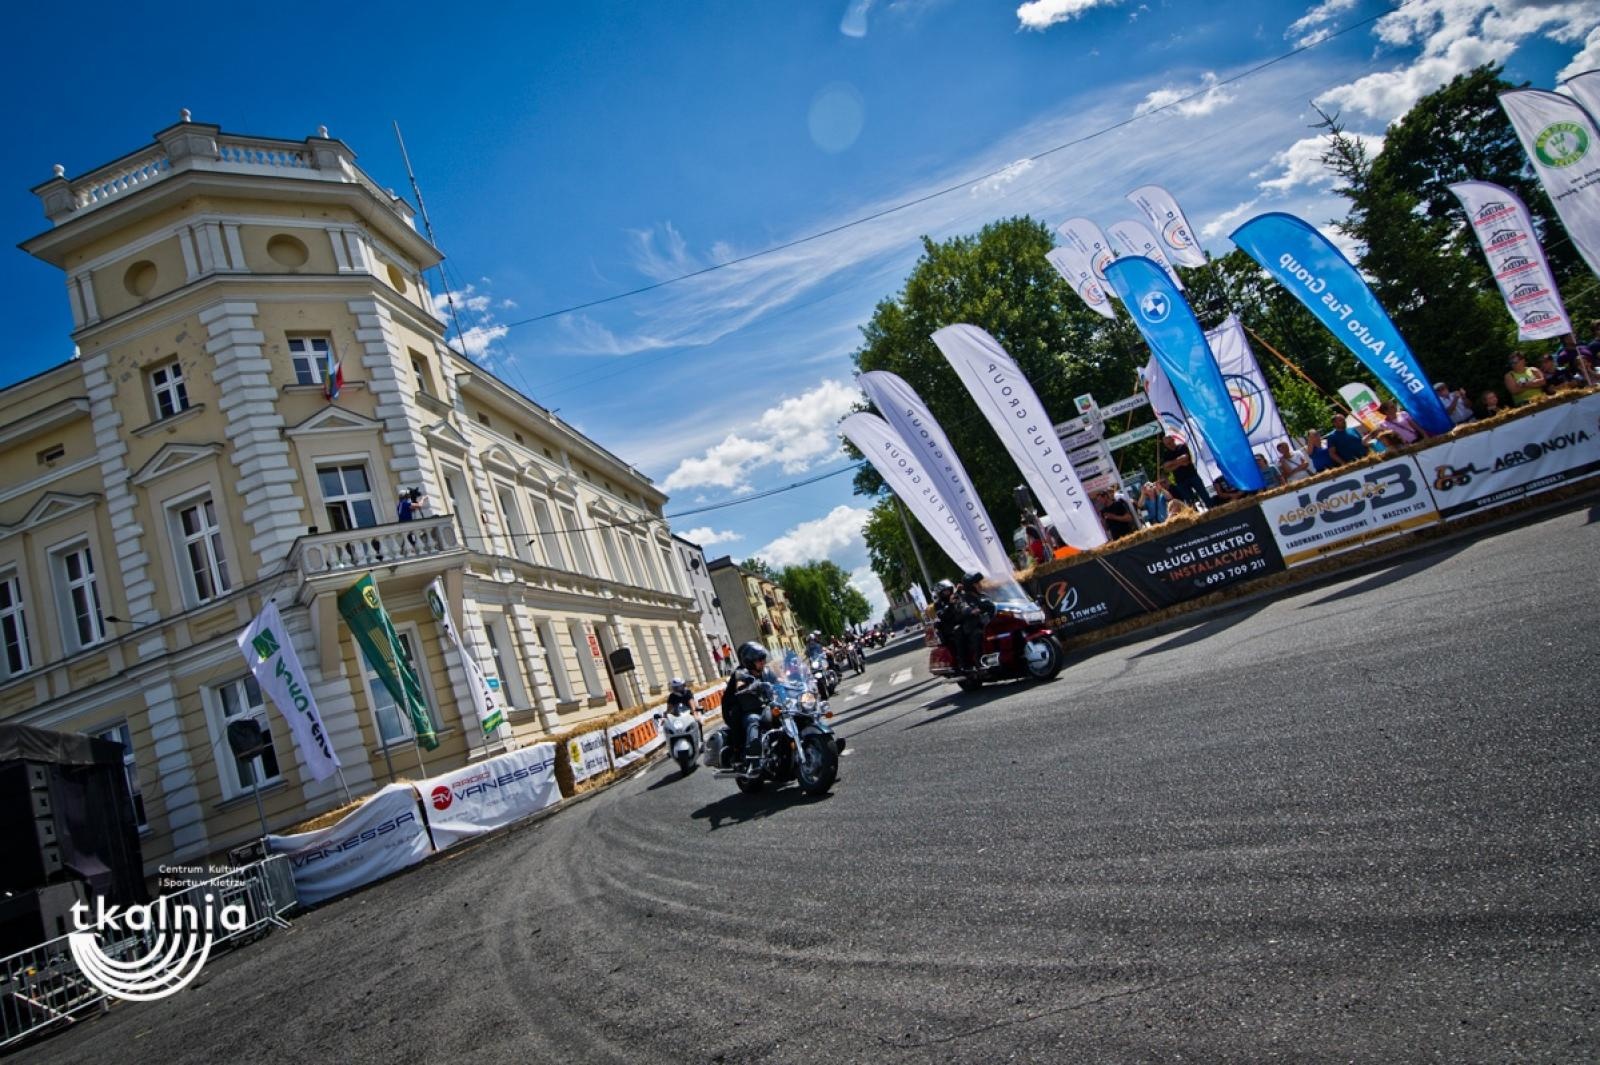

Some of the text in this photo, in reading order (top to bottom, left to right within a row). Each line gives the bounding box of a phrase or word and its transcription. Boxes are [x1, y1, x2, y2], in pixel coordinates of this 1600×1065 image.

[1494, 430, 1589, 470] AGRONOVA
[1278, 489, 1360, 525] AGRONOVA
[1279, 463, 1418, 537] JCB
[1381, 505, 1413, 521] MASZYNY
[1146, 532, 1256, 575] USŁUGI ELEKTRO
[1169, 543, 1262, 581] INSTALACYJNE
[1206, 558, 1266, 584] 693 709 211
[452, 770, 490, 789] RADIO
[292, 811, 415, 867] VANESSA
